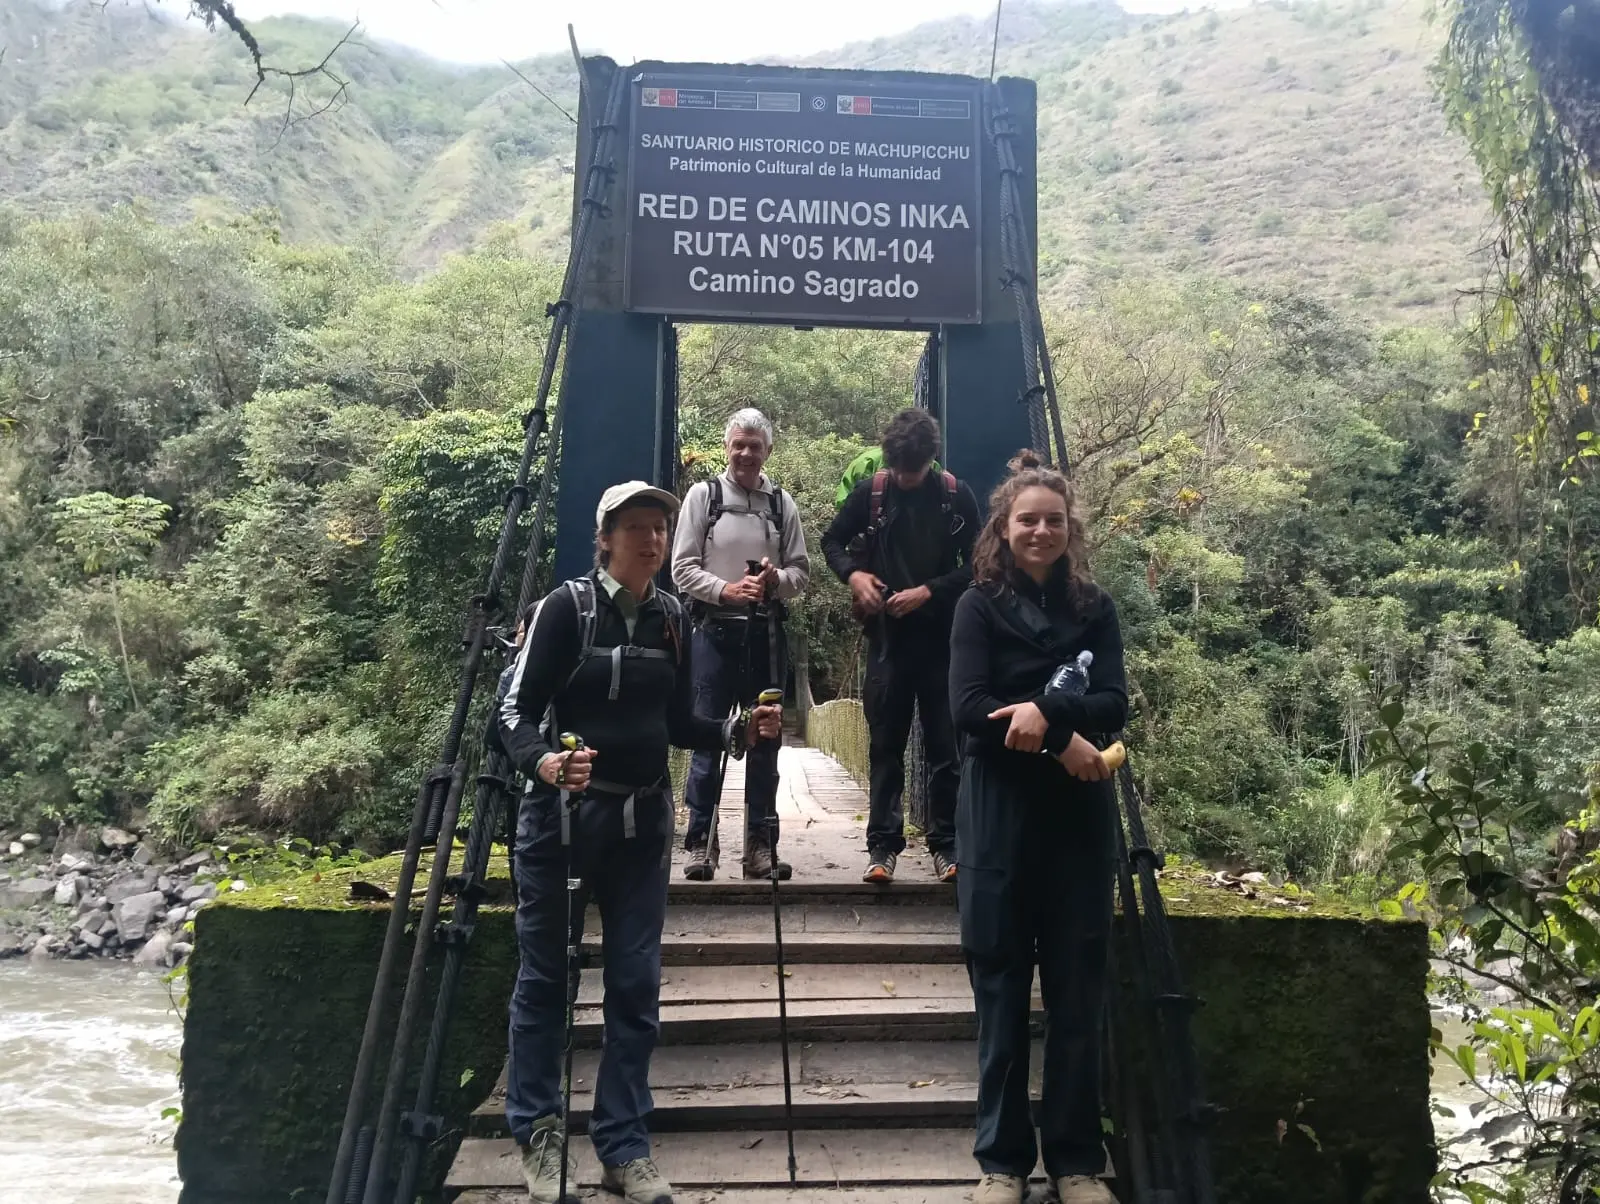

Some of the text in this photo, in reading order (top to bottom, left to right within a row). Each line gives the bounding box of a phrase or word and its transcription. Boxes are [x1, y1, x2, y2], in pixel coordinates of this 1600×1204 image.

[641, 133, 970, 160] SANTUARIO HISTORICO DE MACHUPICCHU
[669, 156, 941, 181] Patrimonio Cultural de la Humanidad
[638, 192, 970, 229] RED DE CAMINOS INKA
[673, 230, 752, 258] RUTA
[833, 236, 935, 264] KM-104
[688, 266, 919, 303] Camino Sagrado
